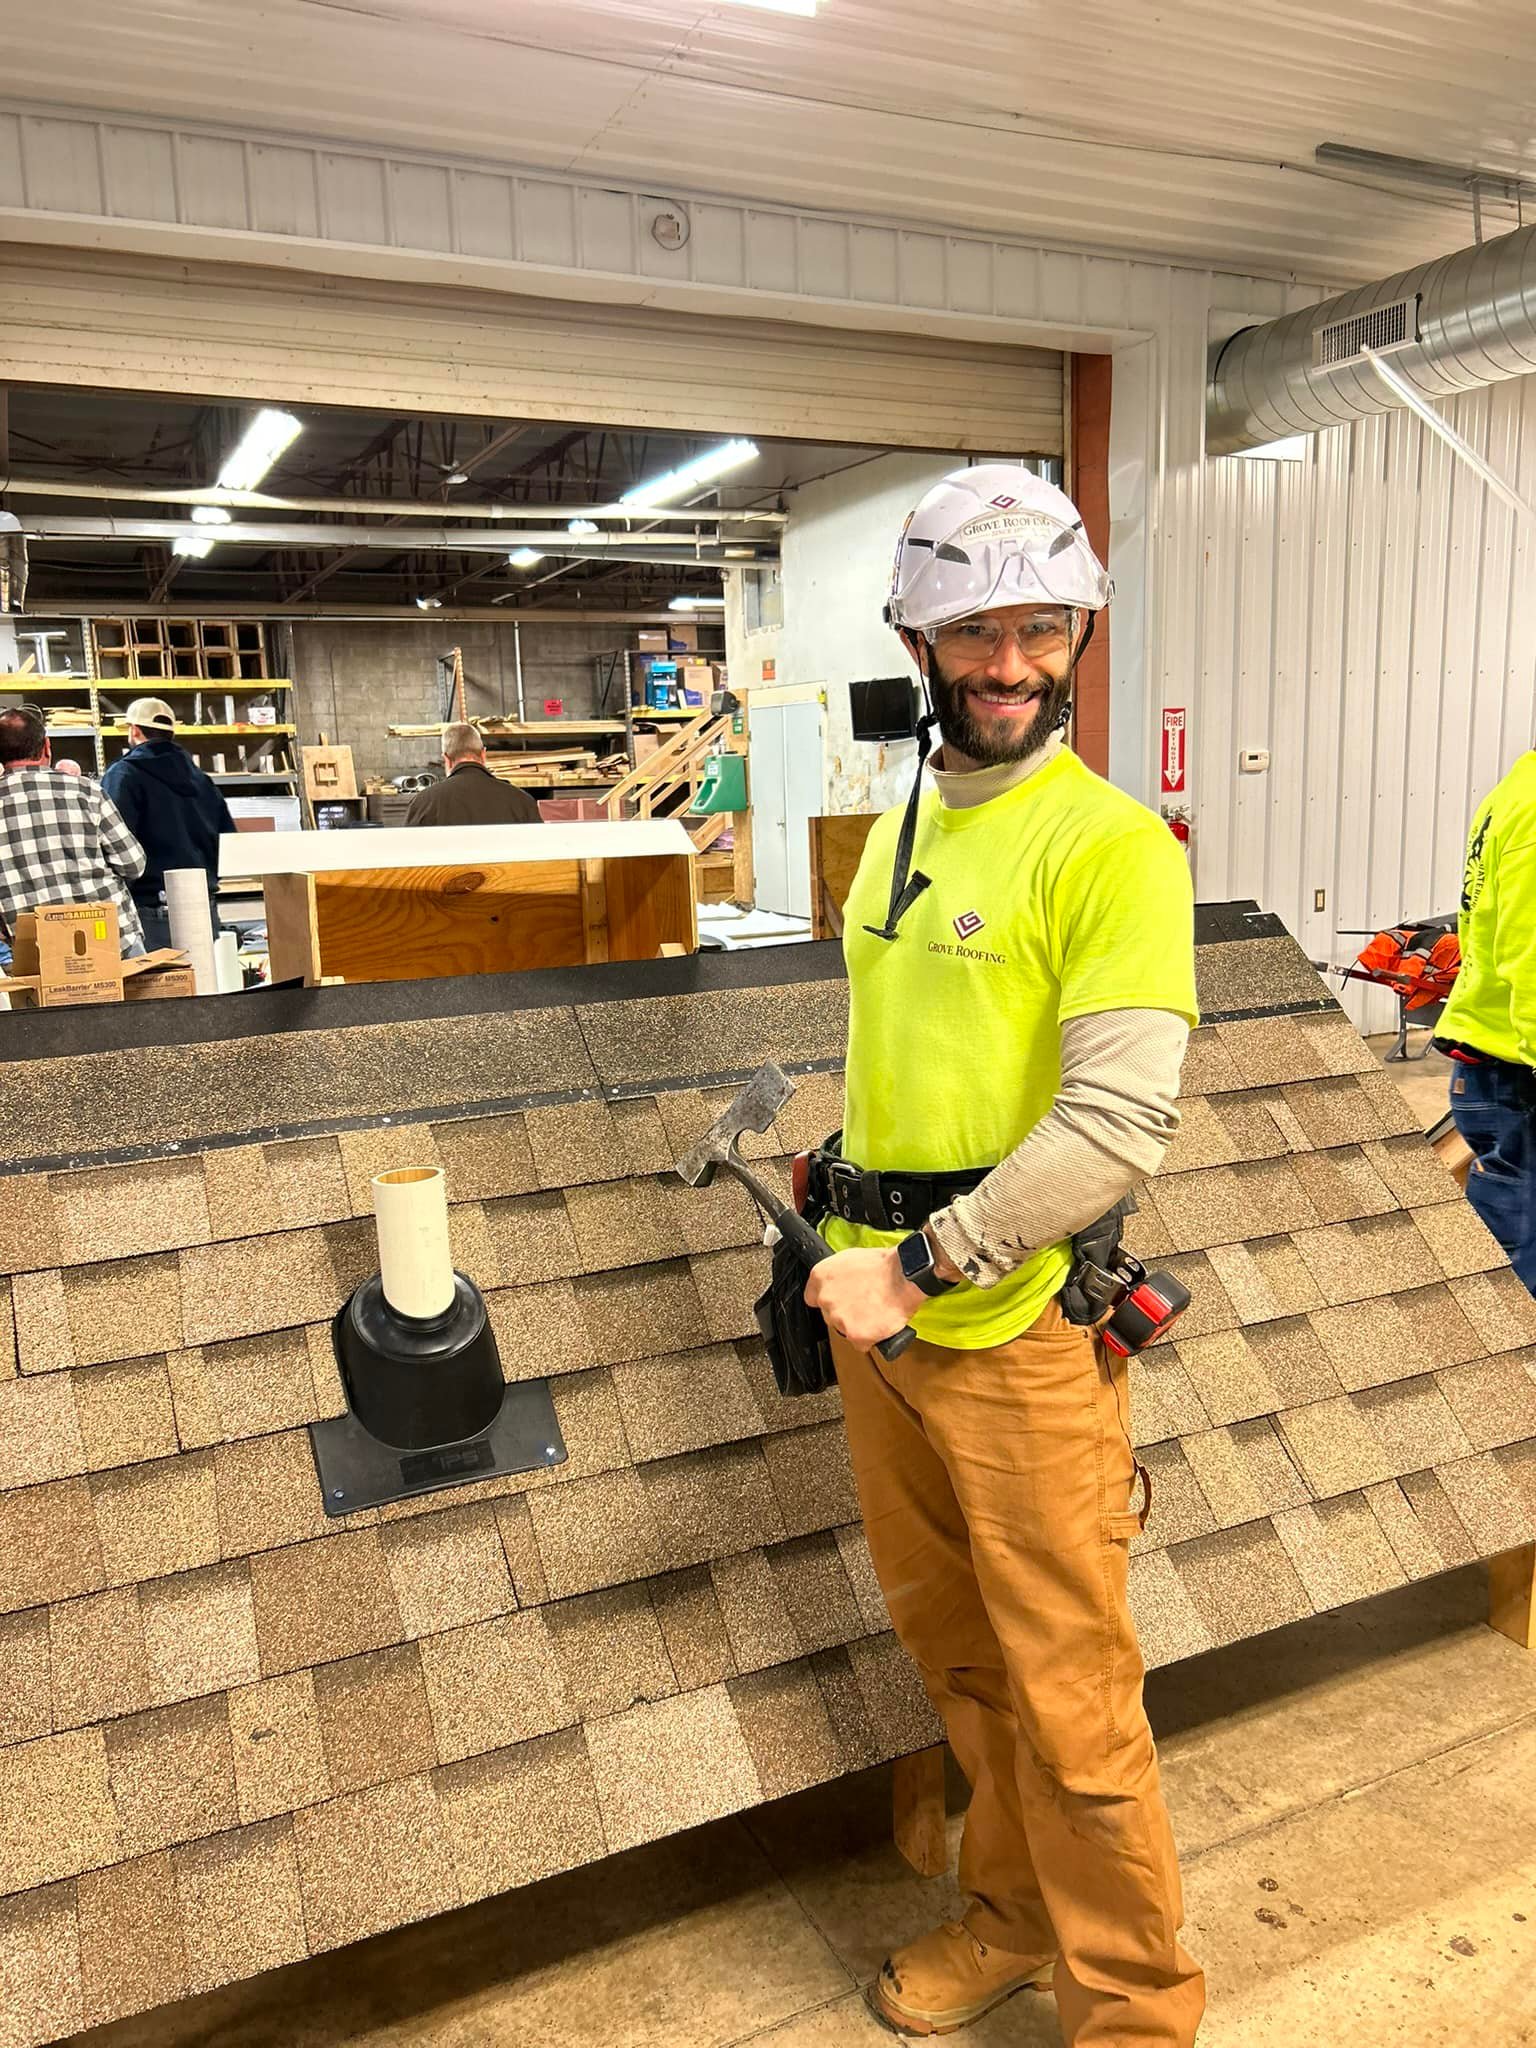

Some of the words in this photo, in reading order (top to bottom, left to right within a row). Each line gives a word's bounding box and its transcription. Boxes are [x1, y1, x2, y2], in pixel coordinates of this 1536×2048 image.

[963, 520, 1001, 536] GROVE
[1003, 517, 1050, 528] ROOFING
[1166, 716, 1183, 727] FIRE
[928, 941, 954, 955] GROVE
[956, 945, 1007, 964] ROOFING
